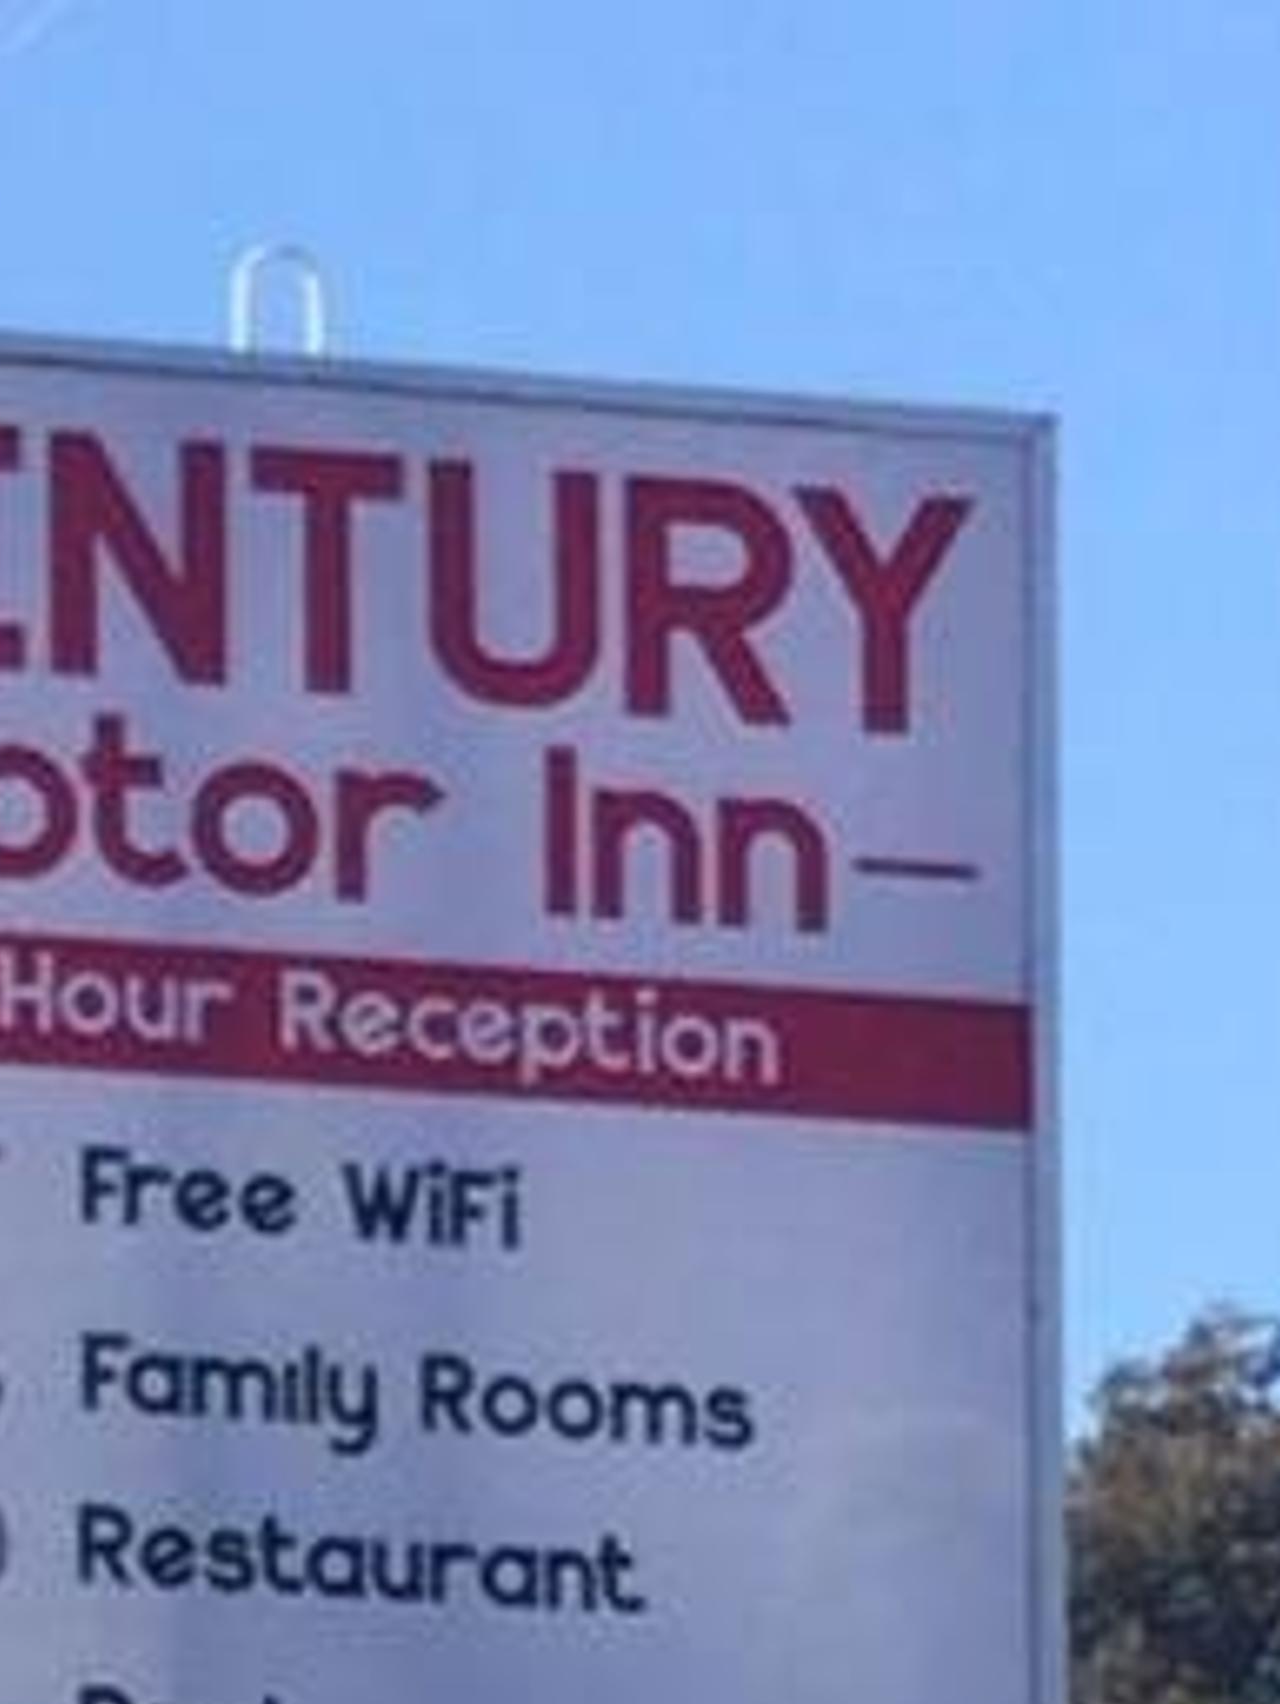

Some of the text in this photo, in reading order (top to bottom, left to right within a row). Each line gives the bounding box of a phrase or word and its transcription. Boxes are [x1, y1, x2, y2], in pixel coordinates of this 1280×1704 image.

[546, 746, 827, 932] Inn
[0, 951, 229, 1038] Hour
[283, 972, 775, 1084] Reception
[83, 1146, 518, 1248] Free WiFi
[83, 1333, 753, 1456] Family Rooms
[79, 1504, 644, 1612] Restaurant
